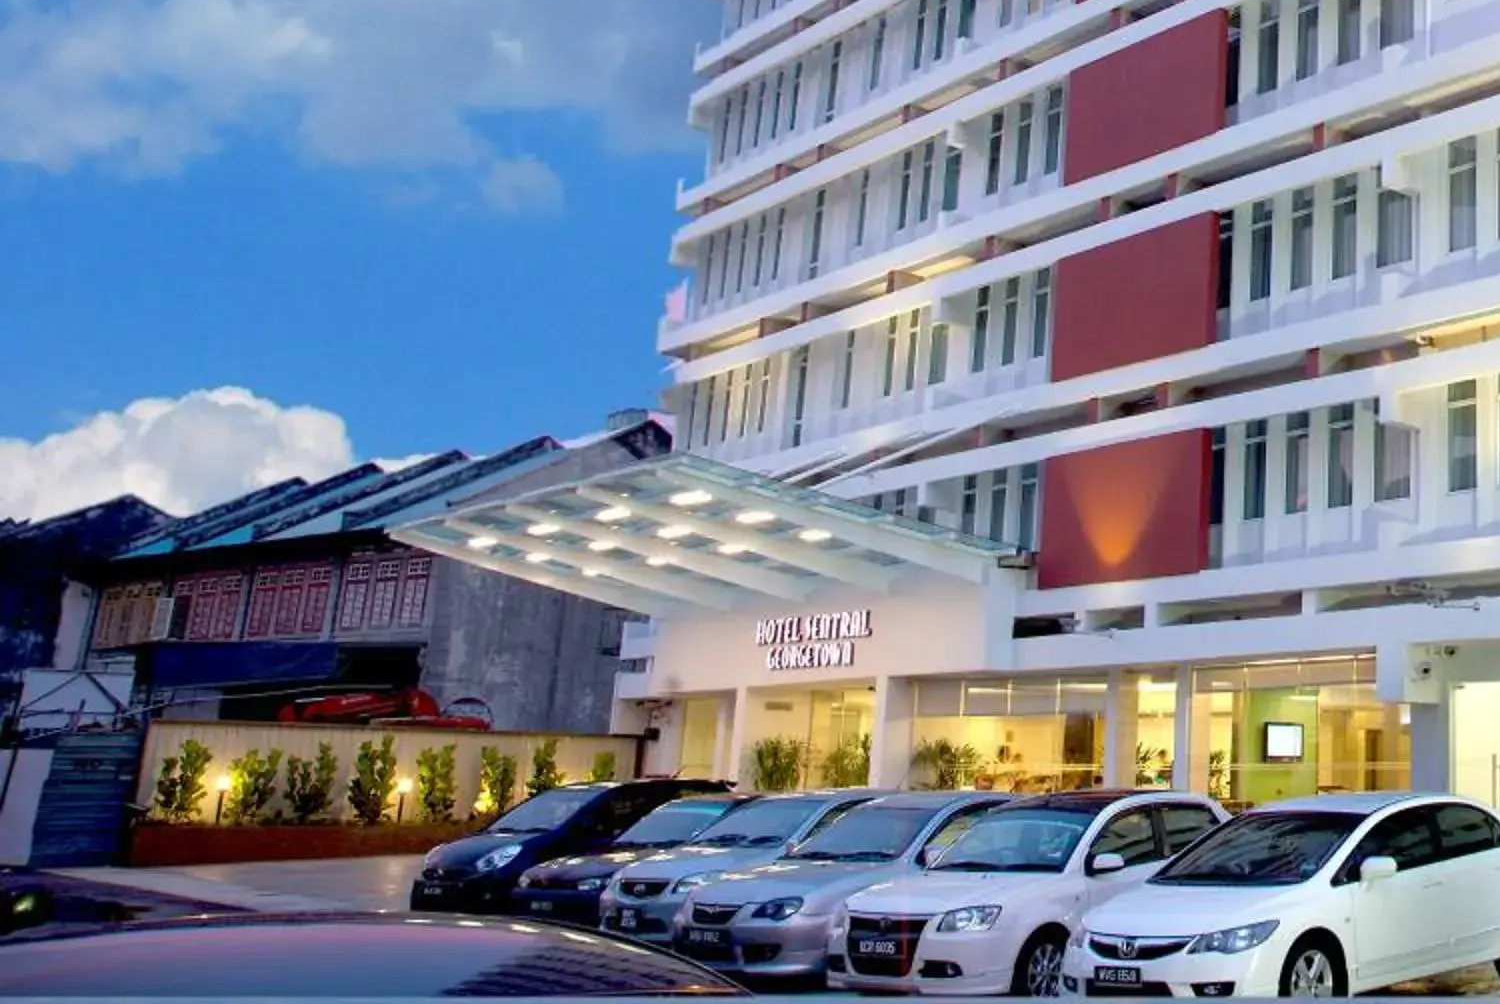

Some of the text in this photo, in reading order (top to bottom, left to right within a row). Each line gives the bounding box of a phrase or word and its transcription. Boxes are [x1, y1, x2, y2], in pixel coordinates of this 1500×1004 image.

[756, 609, 873, 647] HOTEL SENTRAL
[765, 640, 856, 672] GEORGETOWN
